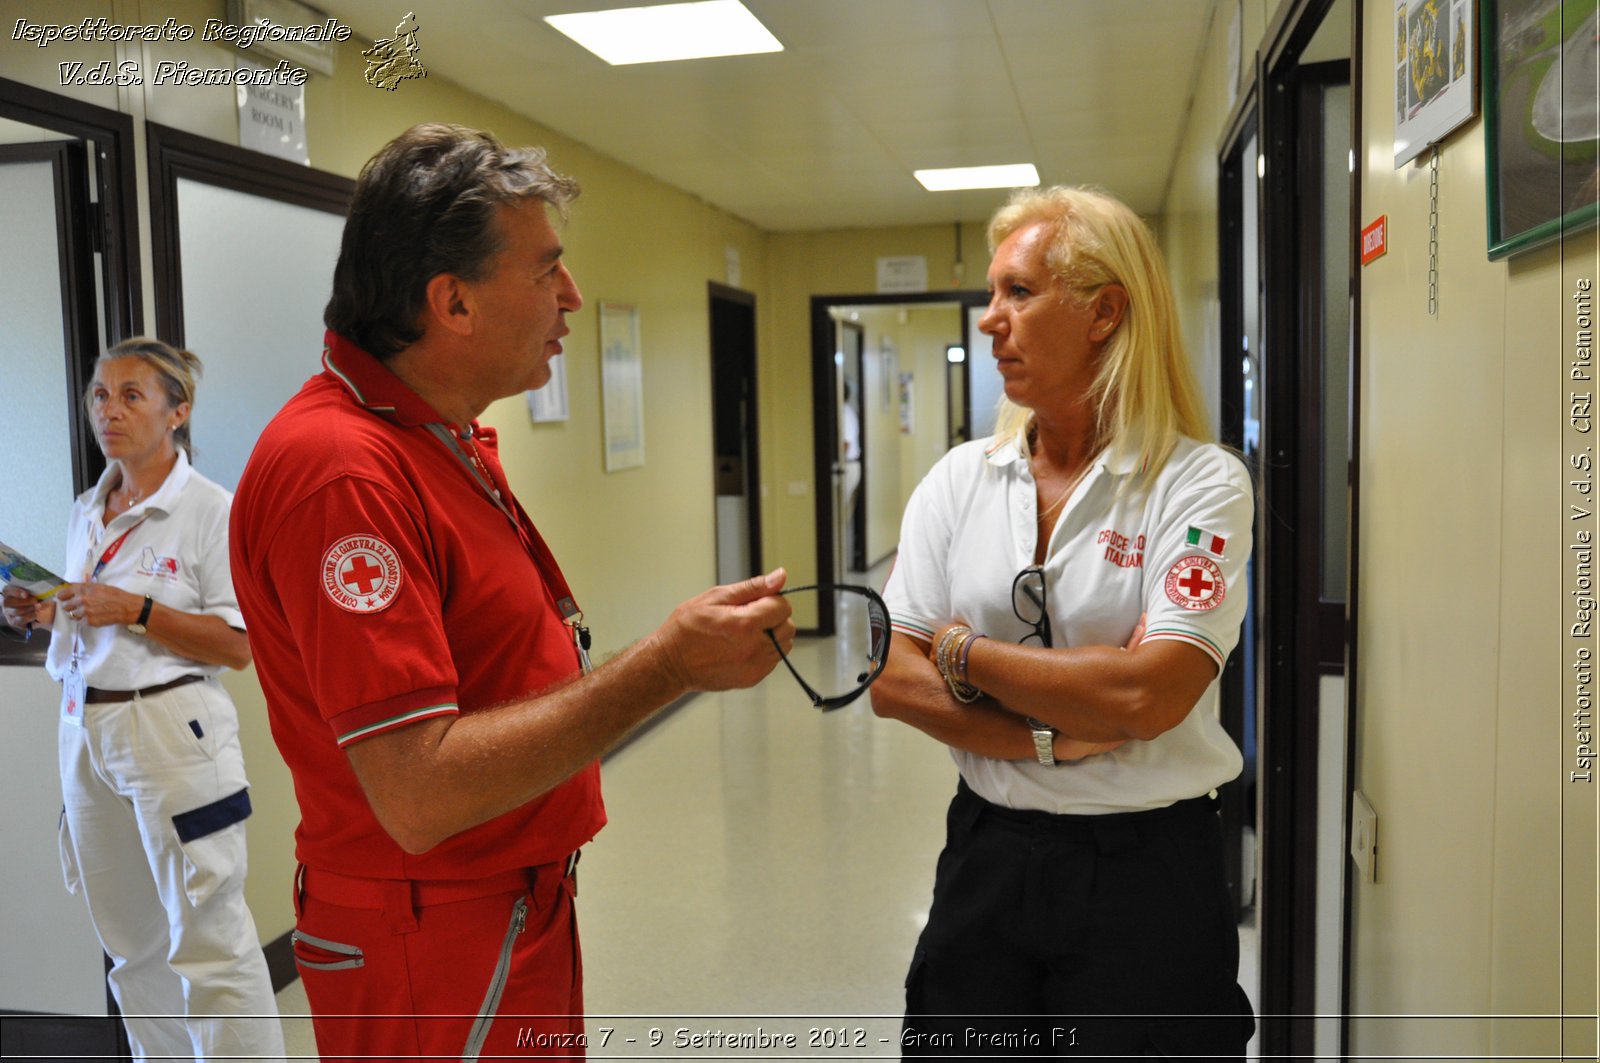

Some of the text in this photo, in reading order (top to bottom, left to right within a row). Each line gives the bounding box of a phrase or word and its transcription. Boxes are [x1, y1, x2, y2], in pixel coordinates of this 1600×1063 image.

[252, 107, 284, 131] ROOM
[1097, 529, 1130, 551] CROCE
[326, 540, 398, 608] CONVENZIONE DI GINEVRA 22 AGOSTO 1864
